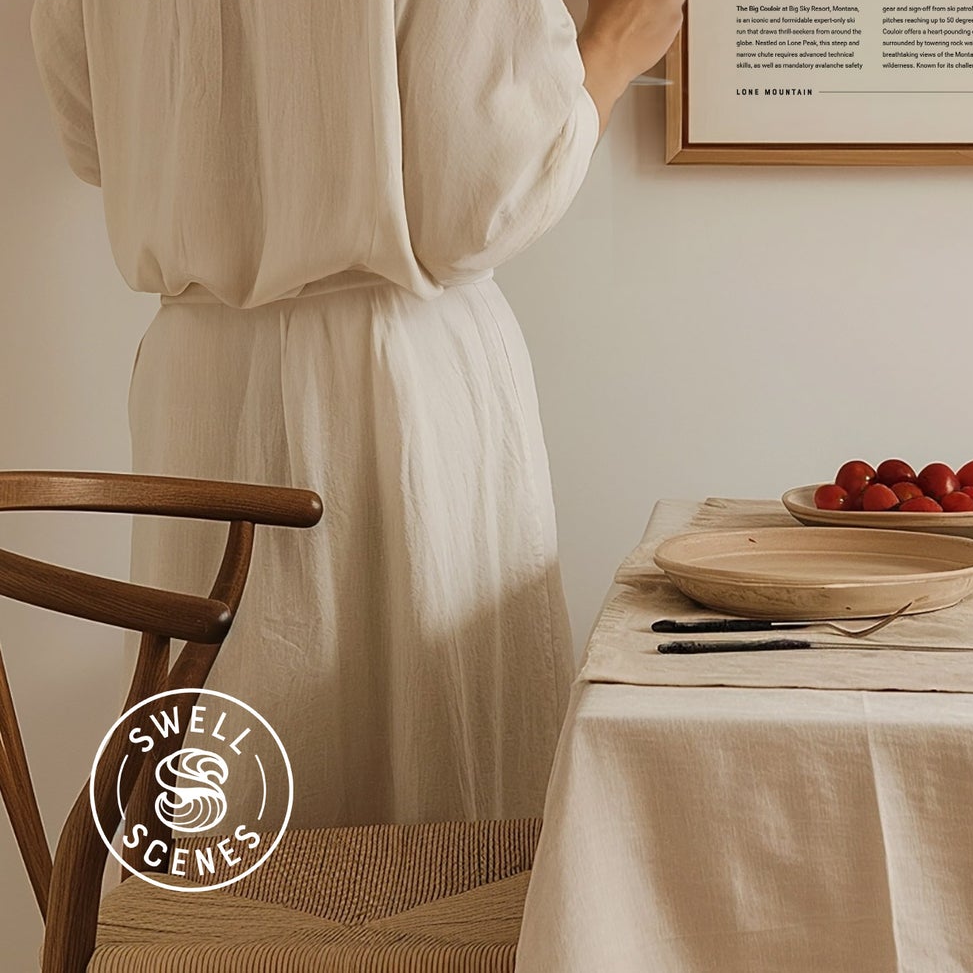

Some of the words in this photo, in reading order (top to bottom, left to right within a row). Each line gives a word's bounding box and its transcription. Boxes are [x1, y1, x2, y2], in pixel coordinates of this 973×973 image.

[748, 5, 759, 13] Big
[788, 5, 799, 14] Big
[799, 5, 810, 13] Sky
[882, 17, 904, 25] pitches
[904, 17, 930, 25] reaching
[916, 39, 924, 48] by
[782, 62, 814, 70] mandatory
[845, 62, 863, 70] safety
